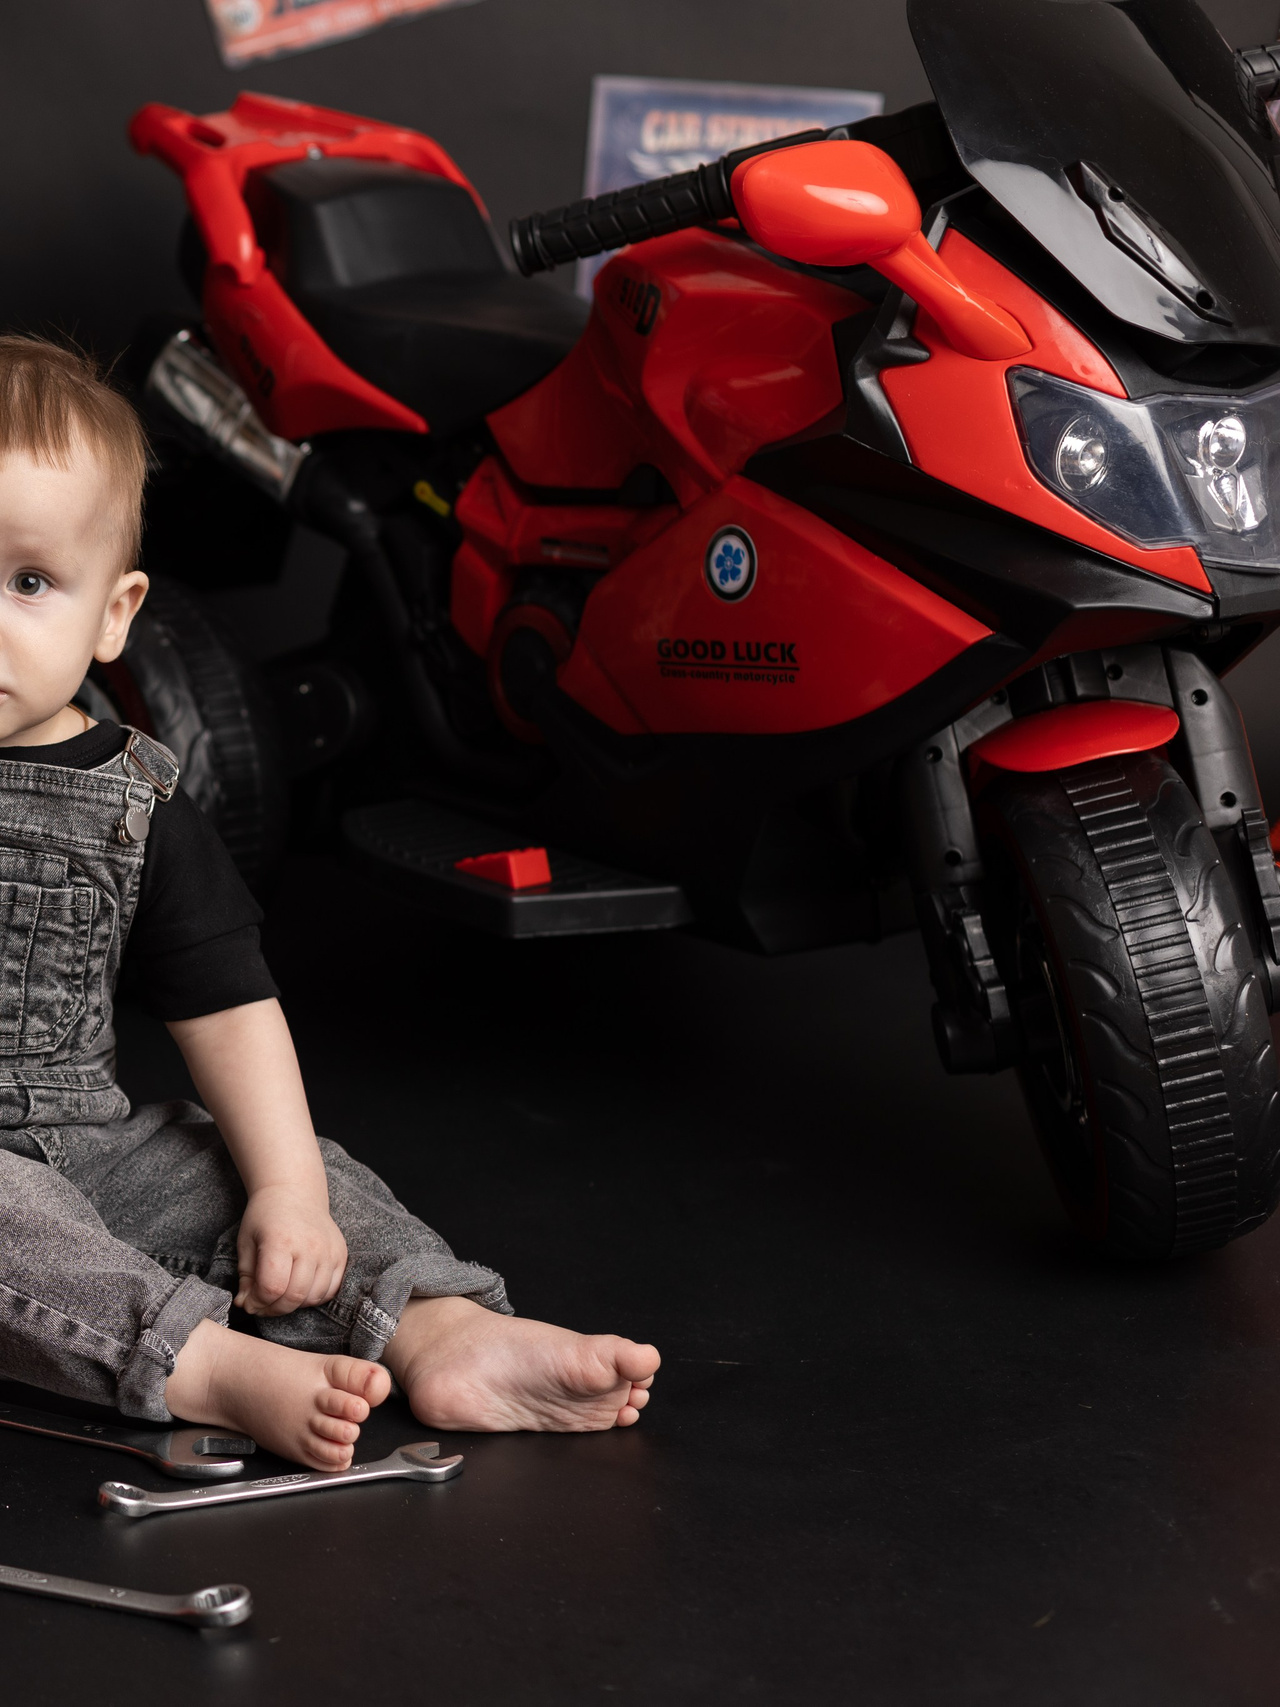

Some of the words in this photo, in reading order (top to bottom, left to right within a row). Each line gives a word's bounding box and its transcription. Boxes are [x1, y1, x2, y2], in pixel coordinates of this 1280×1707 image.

[641, 109, 701, 153] CAR
[657, 638, 727, 661] GOOD
[733, 640, 798, 664] LUCK
[733, 670, 796, 686] motorcycle
